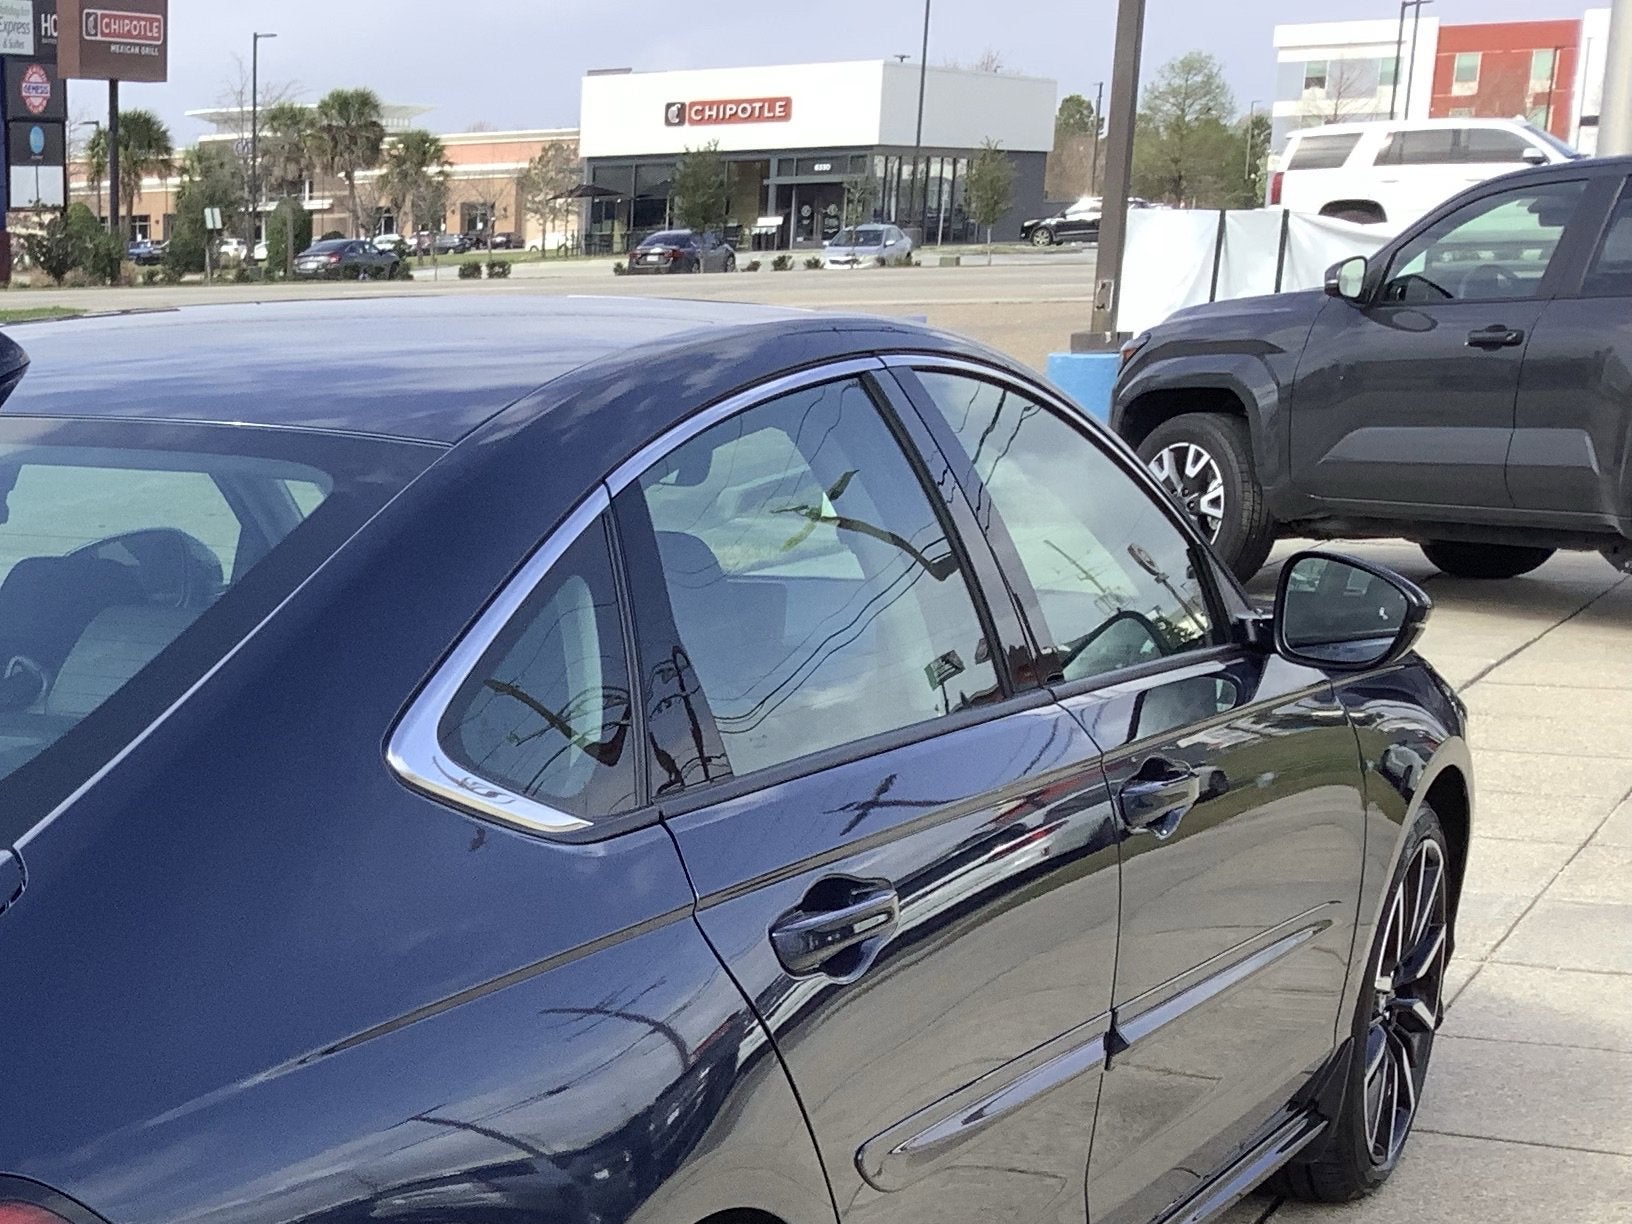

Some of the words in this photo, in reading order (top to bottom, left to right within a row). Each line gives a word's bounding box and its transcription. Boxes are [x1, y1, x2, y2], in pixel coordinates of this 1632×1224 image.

[102, 18, 159, 37] CHIPOTLE
[110, 43, 140, 54] MEXICAN
[140, 46, 159, 56] GRILL
[690, 101, 787, 121] CHIPOTLE
